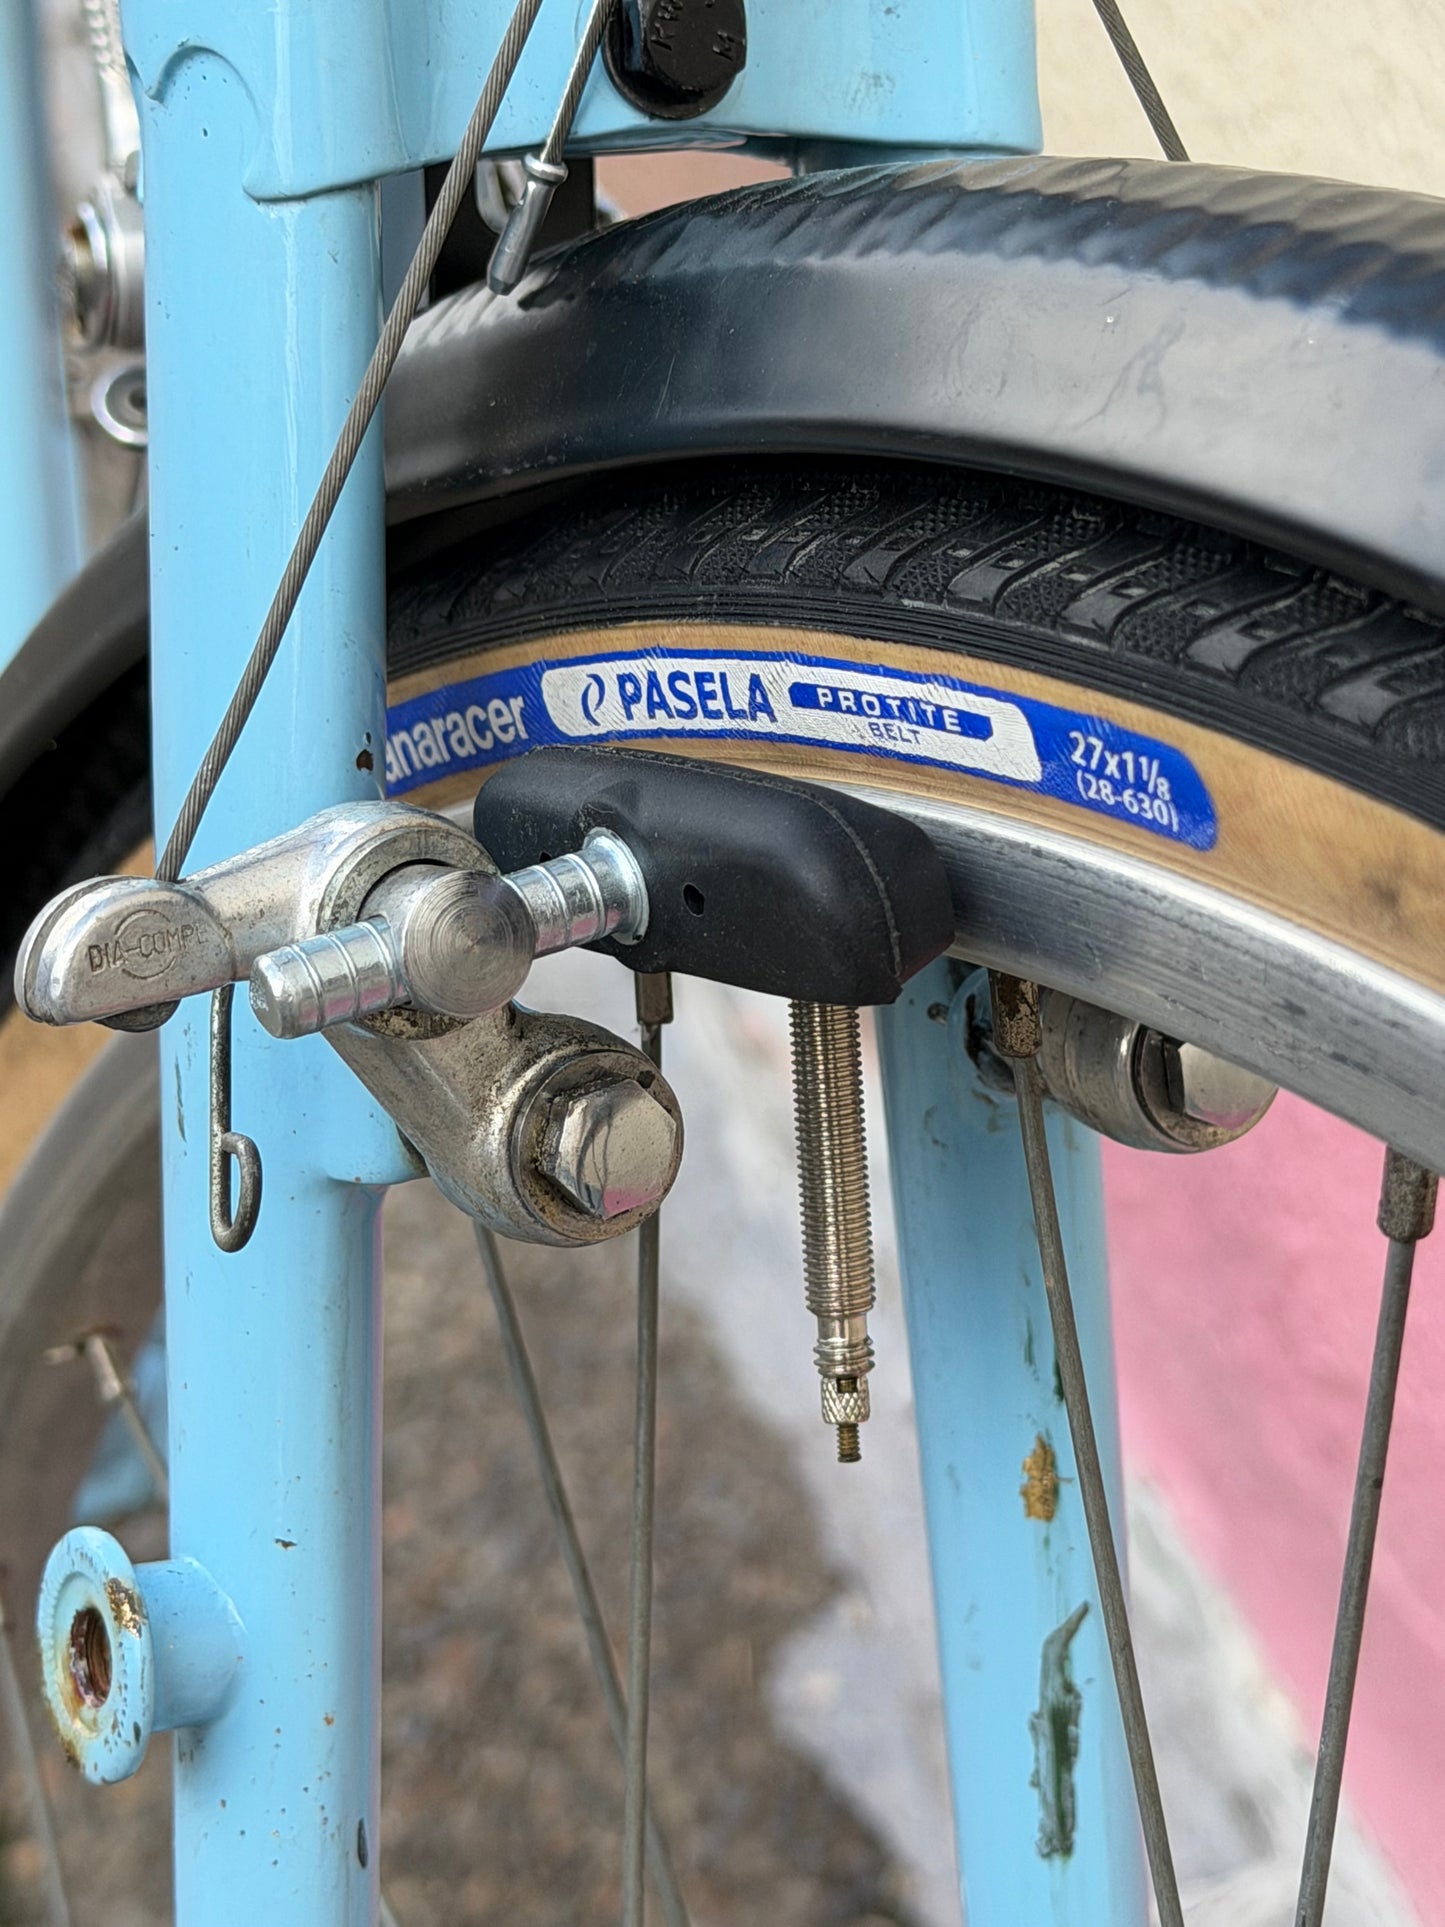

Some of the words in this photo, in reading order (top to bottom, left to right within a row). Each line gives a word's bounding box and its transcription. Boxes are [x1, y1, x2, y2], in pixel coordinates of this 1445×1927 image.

[617, 670, 778, 723] PASELA
[816, 687, 963, 733] PROTITE
[868, 721, 921, 746] BELT
[1076, 769, 1179, 832] (28-630)
[87, 922, 209, 974] DIA-COMPE
